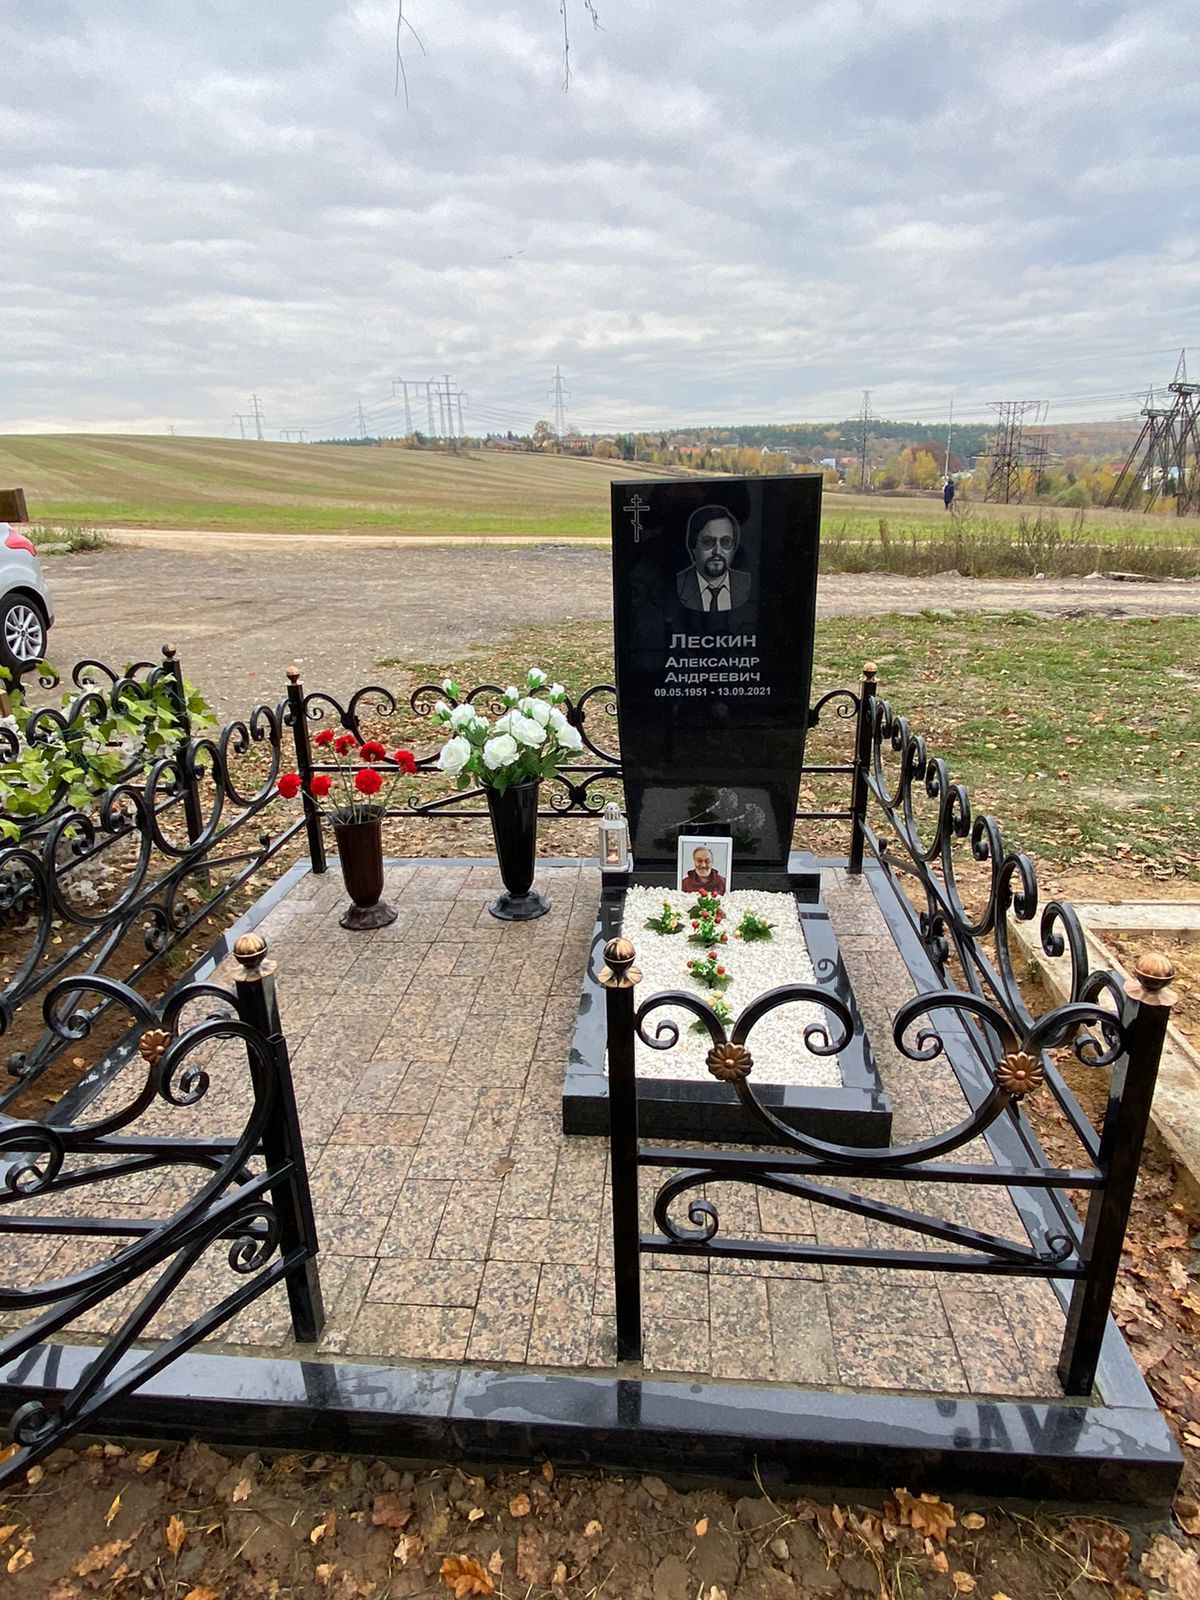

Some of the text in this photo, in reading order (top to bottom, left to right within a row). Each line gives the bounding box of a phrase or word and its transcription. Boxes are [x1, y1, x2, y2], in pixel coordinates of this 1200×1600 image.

[669, 633, 757, 649] ЛЕСКИН
[665, 656, 760, 668] АЛЕКСАНДР
[664, 672, 760, 684] АНДРЕЕВИЧ
[654, 688, 707, 697] 09.05.1951
[717, 687, 771, 696] 13.09.2021
